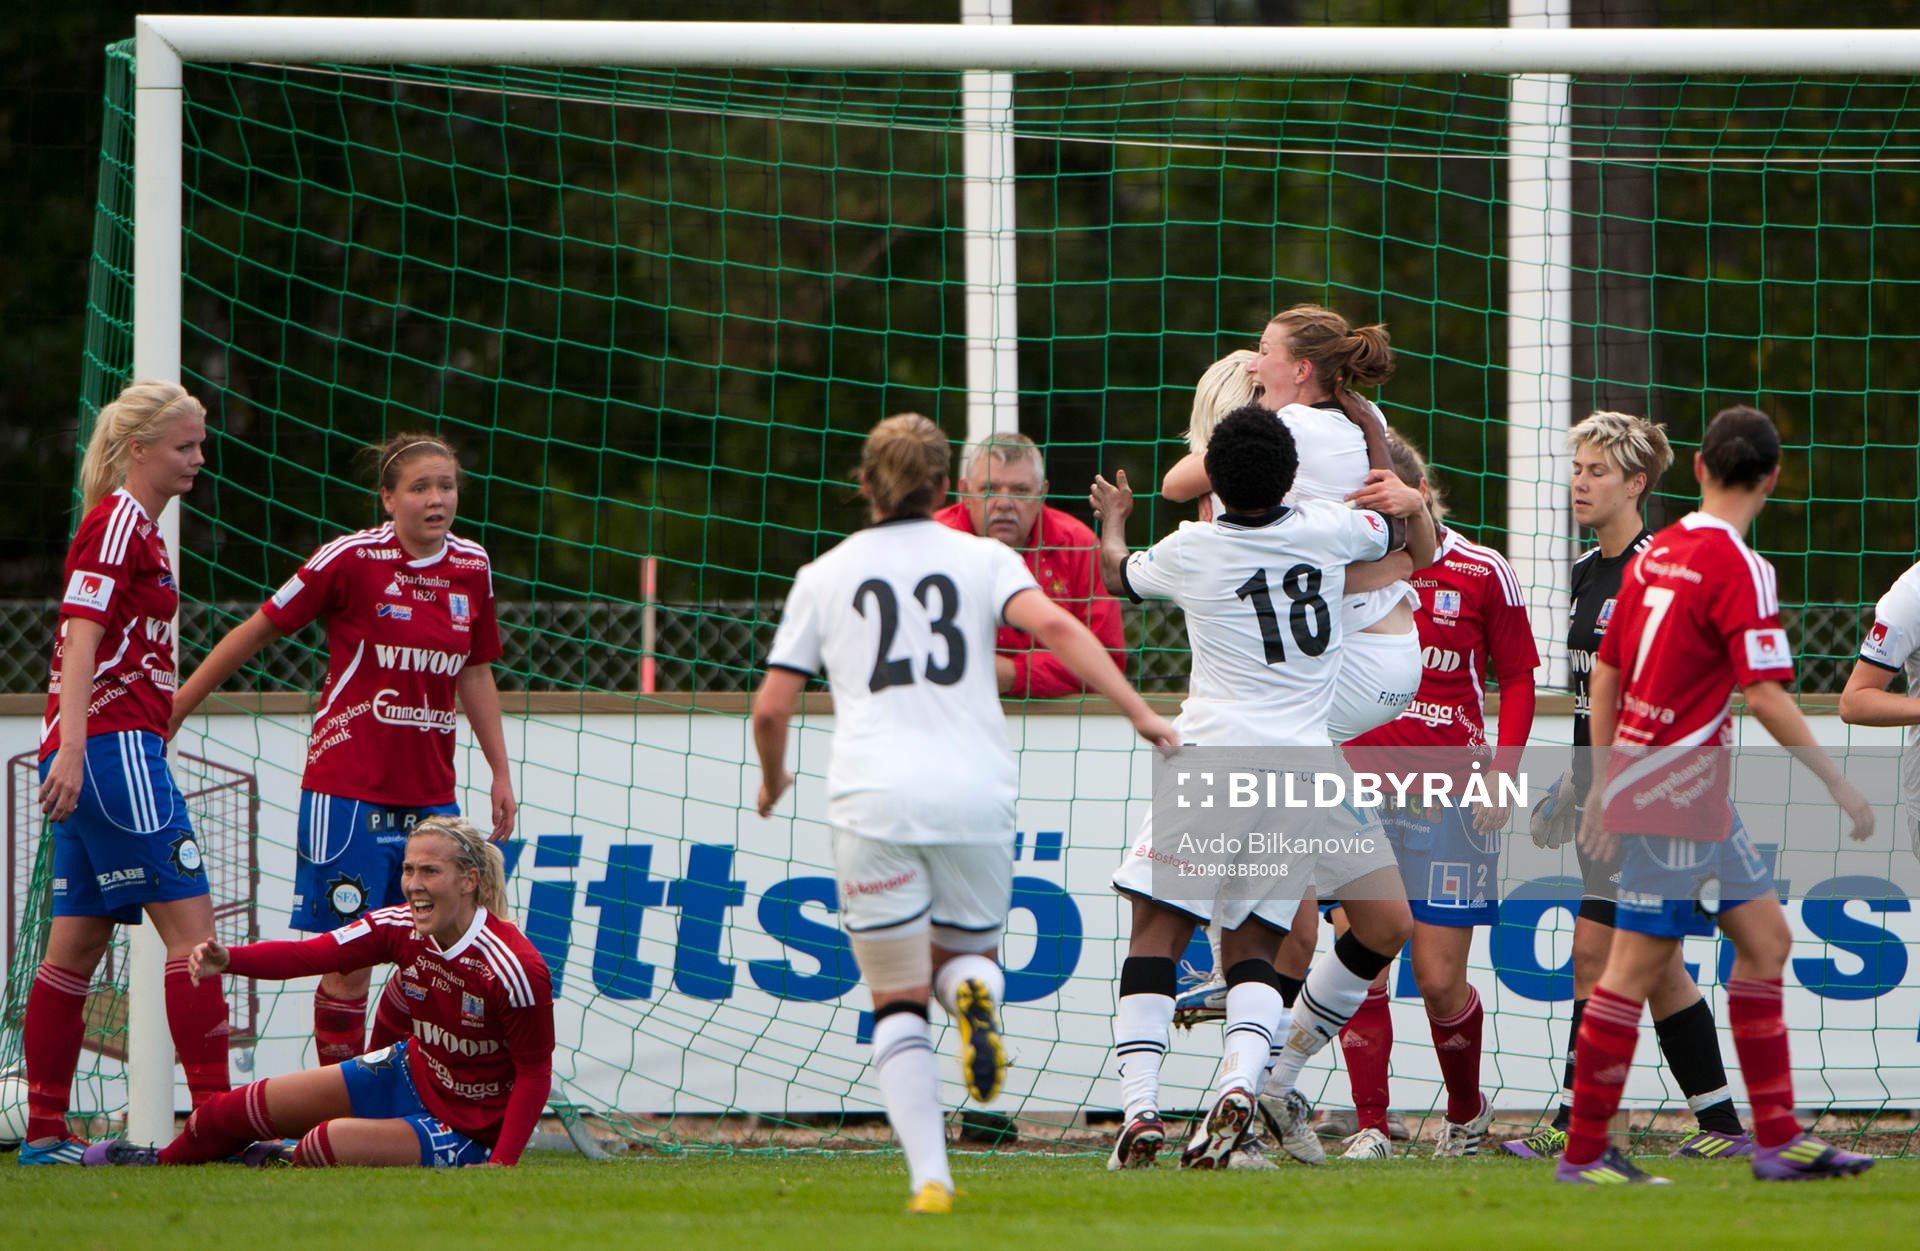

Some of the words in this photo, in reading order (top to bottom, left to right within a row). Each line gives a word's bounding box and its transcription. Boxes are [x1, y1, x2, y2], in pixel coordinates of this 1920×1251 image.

[366, 548, 402, 561] NIBE
[394, 571, 451, 589] Sparbanken
[412, 589, 437, 602] 1826
[1235, 563, 1332, 665] 18
[853, 573, 968, 695] 23
[374, 643, 471, 677] WIWOO
[1476, 862, 1489, 888] 2
[334, 890, 361, 904] SFA
[486, 833, 1084, 1045] ittsö
